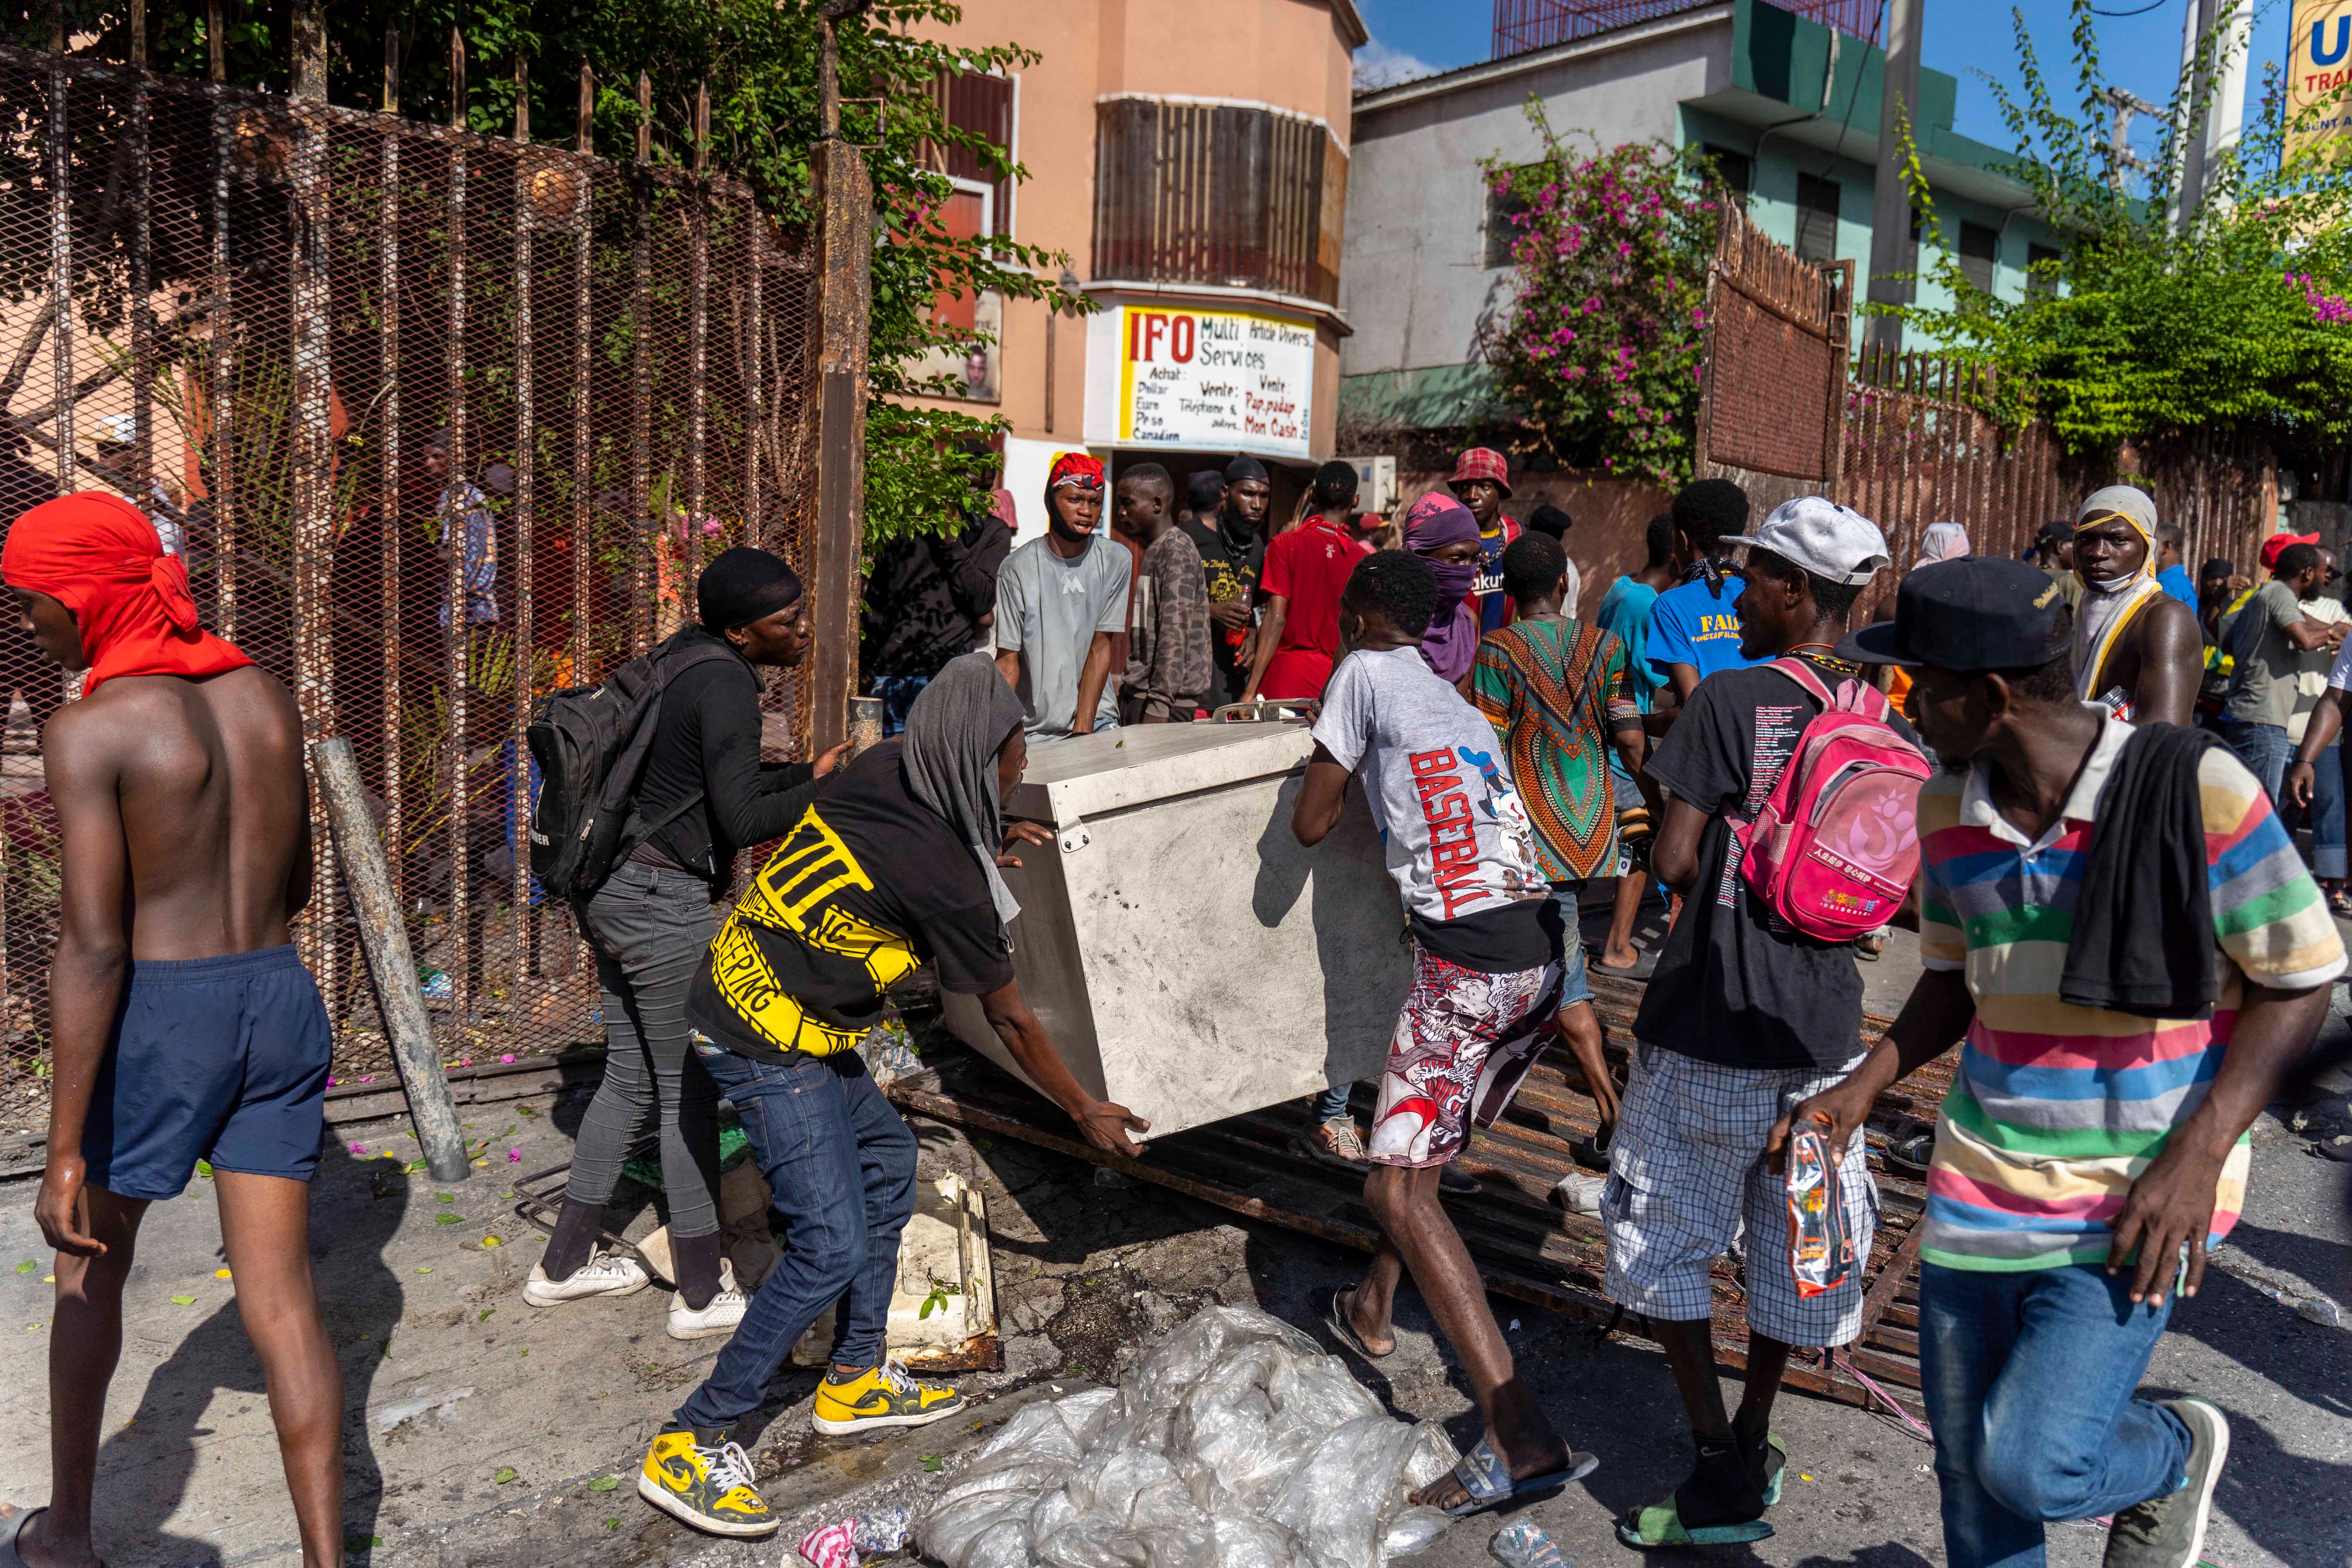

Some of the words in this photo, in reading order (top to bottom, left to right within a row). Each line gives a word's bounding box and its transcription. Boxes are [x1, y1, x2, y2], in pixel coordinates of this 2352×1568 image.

[2305, 69, 2352, 93] TRA
[1129, 313, 1195, 364] IFO
[1200, 317, 1239, 340] Multi
[1250, 320, 1275, 341] Article
[1200, 341, 1265, 370] Services
[1138, 382, 1168, 395] Dollar
[1200, 381, 1239, 398] Vente:
[1136, 397, 1160, 410] Euro
[1133, 427, 1180, 441] Canadien
[1244, 415, 1266, 436] Mon
[1271, 417, 1297, 439] Cash
[1408, 747, 1493, 920] BASEBALL
